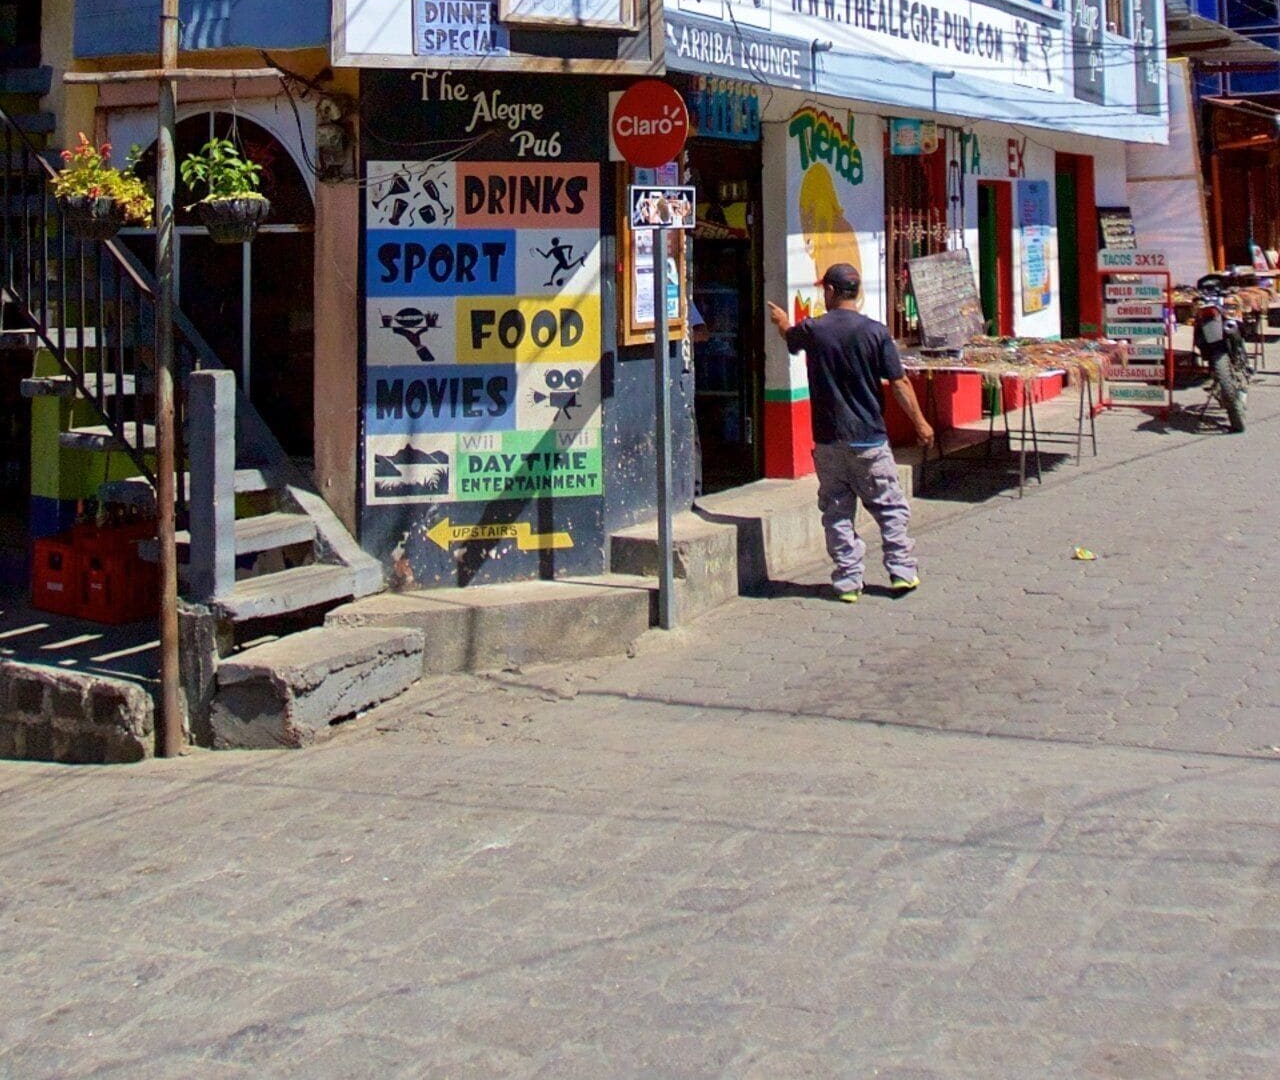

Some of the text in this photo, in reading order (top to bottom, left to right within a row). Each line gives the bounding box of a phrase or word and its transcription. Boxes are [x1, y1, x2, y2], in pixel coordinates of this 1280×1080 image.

[423, 29, 500, 51] SPECIAL
[677, 24, 802, 80] ARRIBA LOUNGE
[412, 72, 468, 102] The
[465, 92, 544, 132] Alegre
[616, 117, 672, 136] Claro
[510, 129, 562, 158] Pub
[789, 110, 864, 186] Tienda
[464, 176, 589, 215] DRINKS
[376, 242, 506, 285] SPORT
[1103, 252, 1165, 267] TACOS 3X12
[1108, 286, 1133, 298] POLLO
[1117, 305, 1153, 316] CHORIZO
[471, 309, 584, 350] FOOD
[1108, 325, 1164, 336] VEGETARIANO
[375, 376, 509, 420] MOVIES
[460, 474, 599, 492] ENTERTAINMENT
[451, 524, 520, 538] UPSTAIRS
